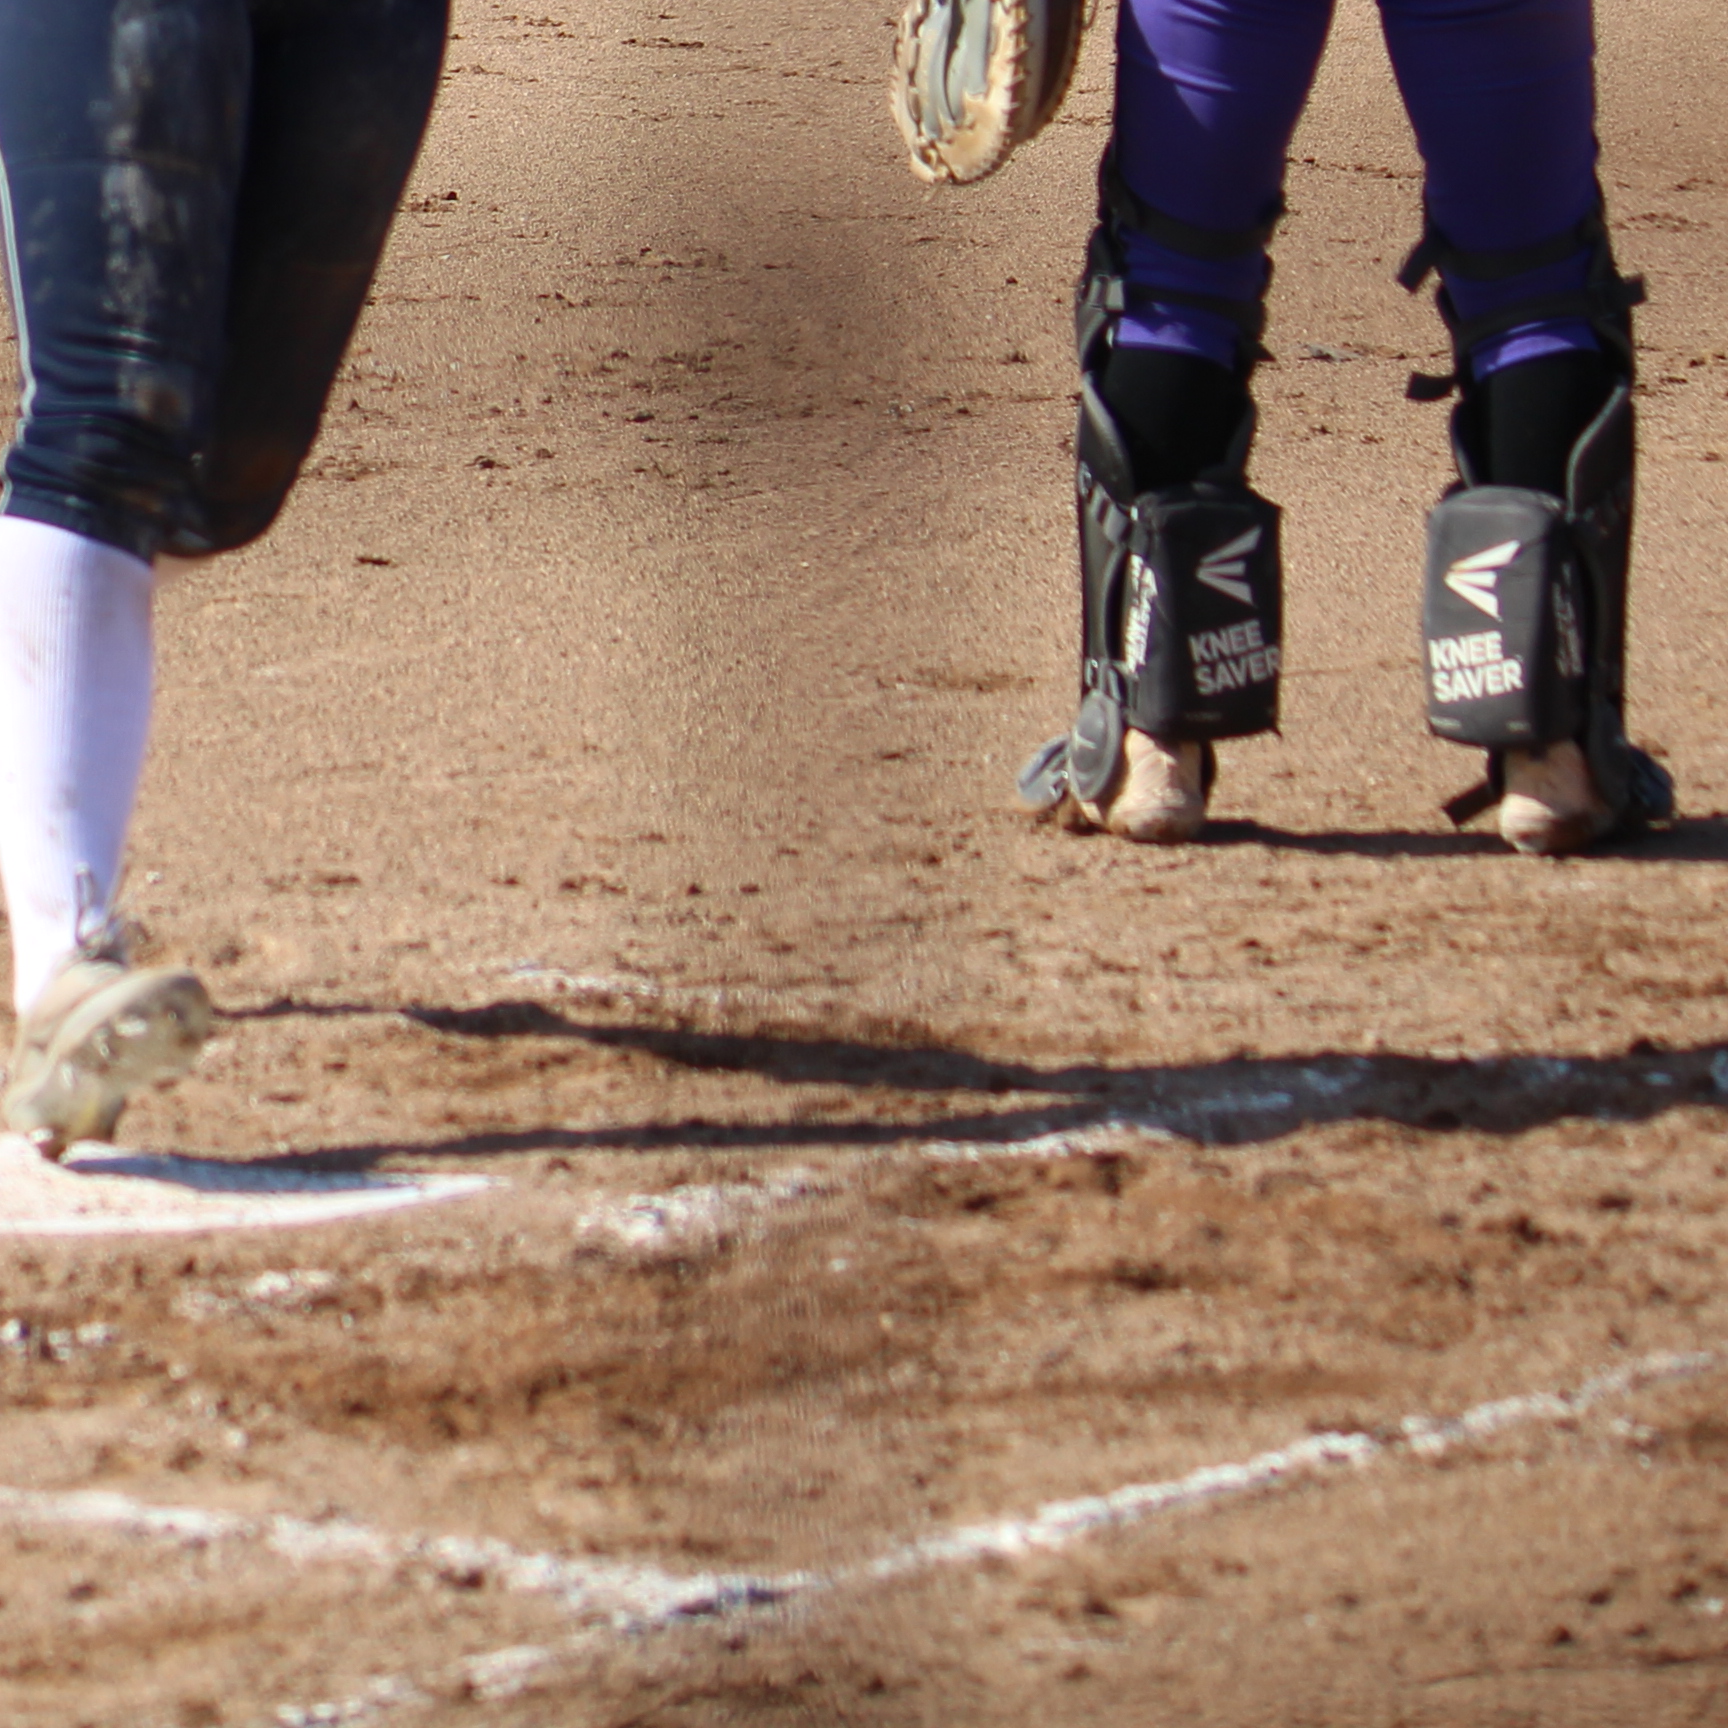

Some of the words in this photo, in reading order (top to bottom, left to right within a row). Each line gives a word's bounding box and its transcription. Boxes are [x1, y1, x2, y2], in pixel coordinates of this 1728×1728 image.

[1188, 618, 1264, 663] KNEE
[1428, 630, 1504, 670] KNEE
[1194, 646, 1280, 696] SAVER
[1432, 658, 1525, 703] SAVER
